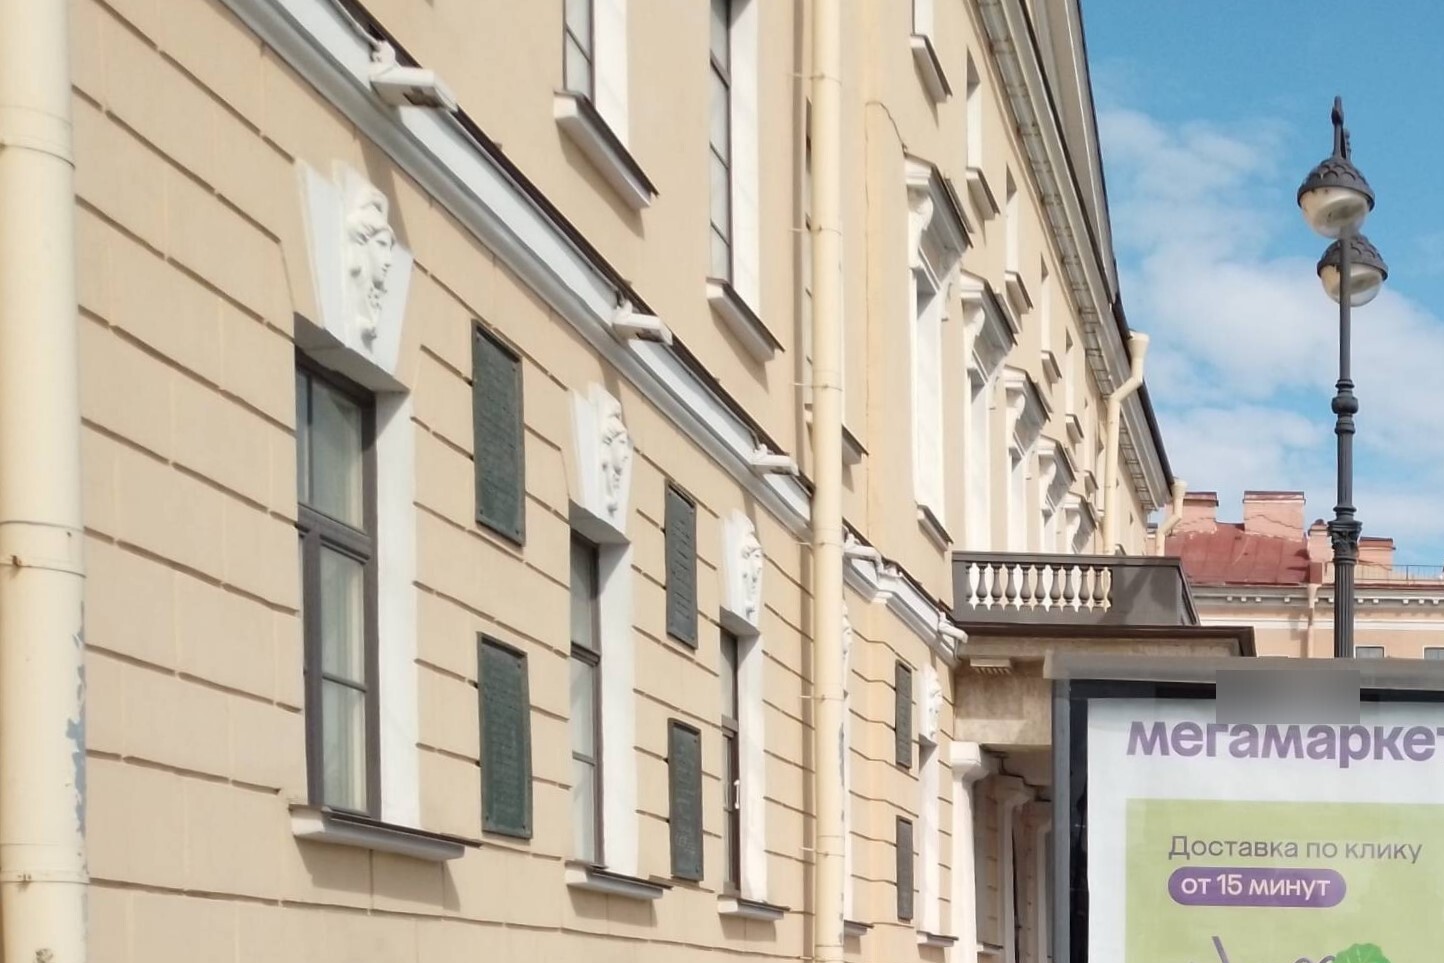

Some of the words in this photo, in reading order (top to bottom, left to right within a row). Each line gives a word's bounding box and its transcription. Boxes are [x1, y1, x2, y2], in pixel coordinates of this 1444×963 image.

[1168, 835, 1299, 861] Доставка
[1306, 841, 1337, 859] по
[1345, 842, 1423, 865] клику
[1180, 876, 1211, 896] от
[1216, 873, 1243, 896] 15
[1249, 877, 1331, 901] минут
